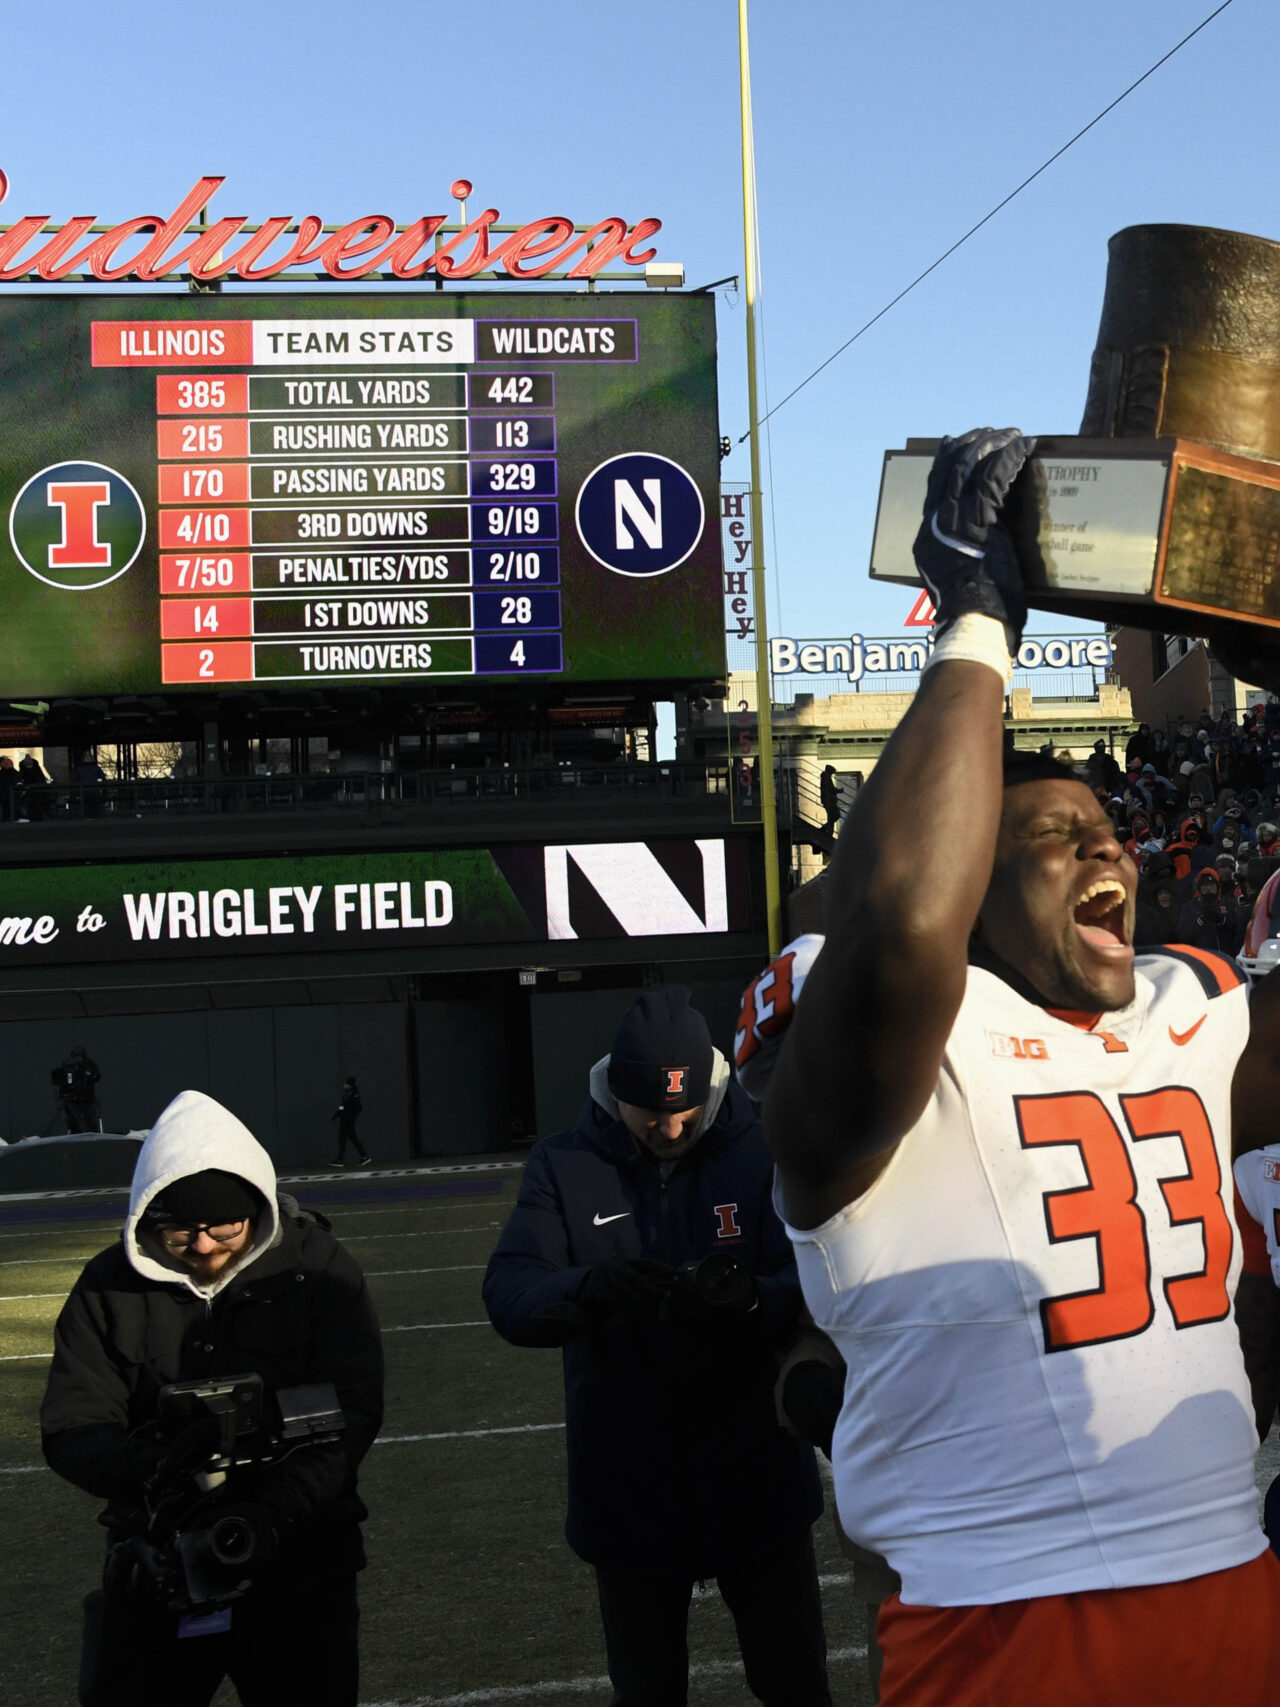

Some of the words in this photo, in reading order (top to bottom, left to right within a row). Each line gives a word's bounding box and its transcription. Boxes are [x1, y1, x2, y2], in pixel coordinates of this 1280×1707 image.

[0, 168, 663, 281] udweiser
[121, 330, 224, 355] ILLINOIS
[267, 333, 348, 353] TEAM
[360, 332, 452, 352] STATS
[493, 328, 614, 353] WILDCATS
[179, 381, 225, 408] 385
[285, 382, 353, 405] TOTAL
[358, 381, 429, 403] YARDS
[489, 377, 532, 402] 442
[182, 425, 222, 452] 215
[274, 425, 371, 449] RUSHING
[377, 424, 448, 447] YARDS
[497, 421, 528, 447] 113
[184, 470, 223, 496] 170
[274, 469, 367, 493] PASSING
[373, 467, 445, 491] YARDS
[490, 464, 535, 490] 329
[1047, 466, 1102, 482] TROPHY
[298, 514, 340, 537] 3RD
[348, 512, 427, 536] DOWNS
[489, 509, 539, 535] 9/19
[615, 479, 663, 550] N
[177, 514, 229, 543] 4/10
[721, 494, 752, 563] Hey
[176, 559, 233, 588] 7/50
[280, 555, 448, 582] PENALTIES/YDS
[491, 553, 539, 581] 2/10
[305, 603, 342, 626] 1ST
[348, 601, 428, 625] DOWNS
[502, 597, 531, 623] 28
[724, 571, 754, 639] Hey
[195, 606, 218, 632] 14
[200, 650, 214, 676] 2
[300, 645, 431, 670] TURNOVERS
[511, 641, 525, 665] 4
[769, 633, 935, 683] Benjami
[1013, 637, 1113, 669] oore
[77, 905, 107, 932] to
[123, 885, 324, 941] WRIGLEY
[334, 880, 454, 932] FIELD
[1011, 1085, 1234, 1354] 33
